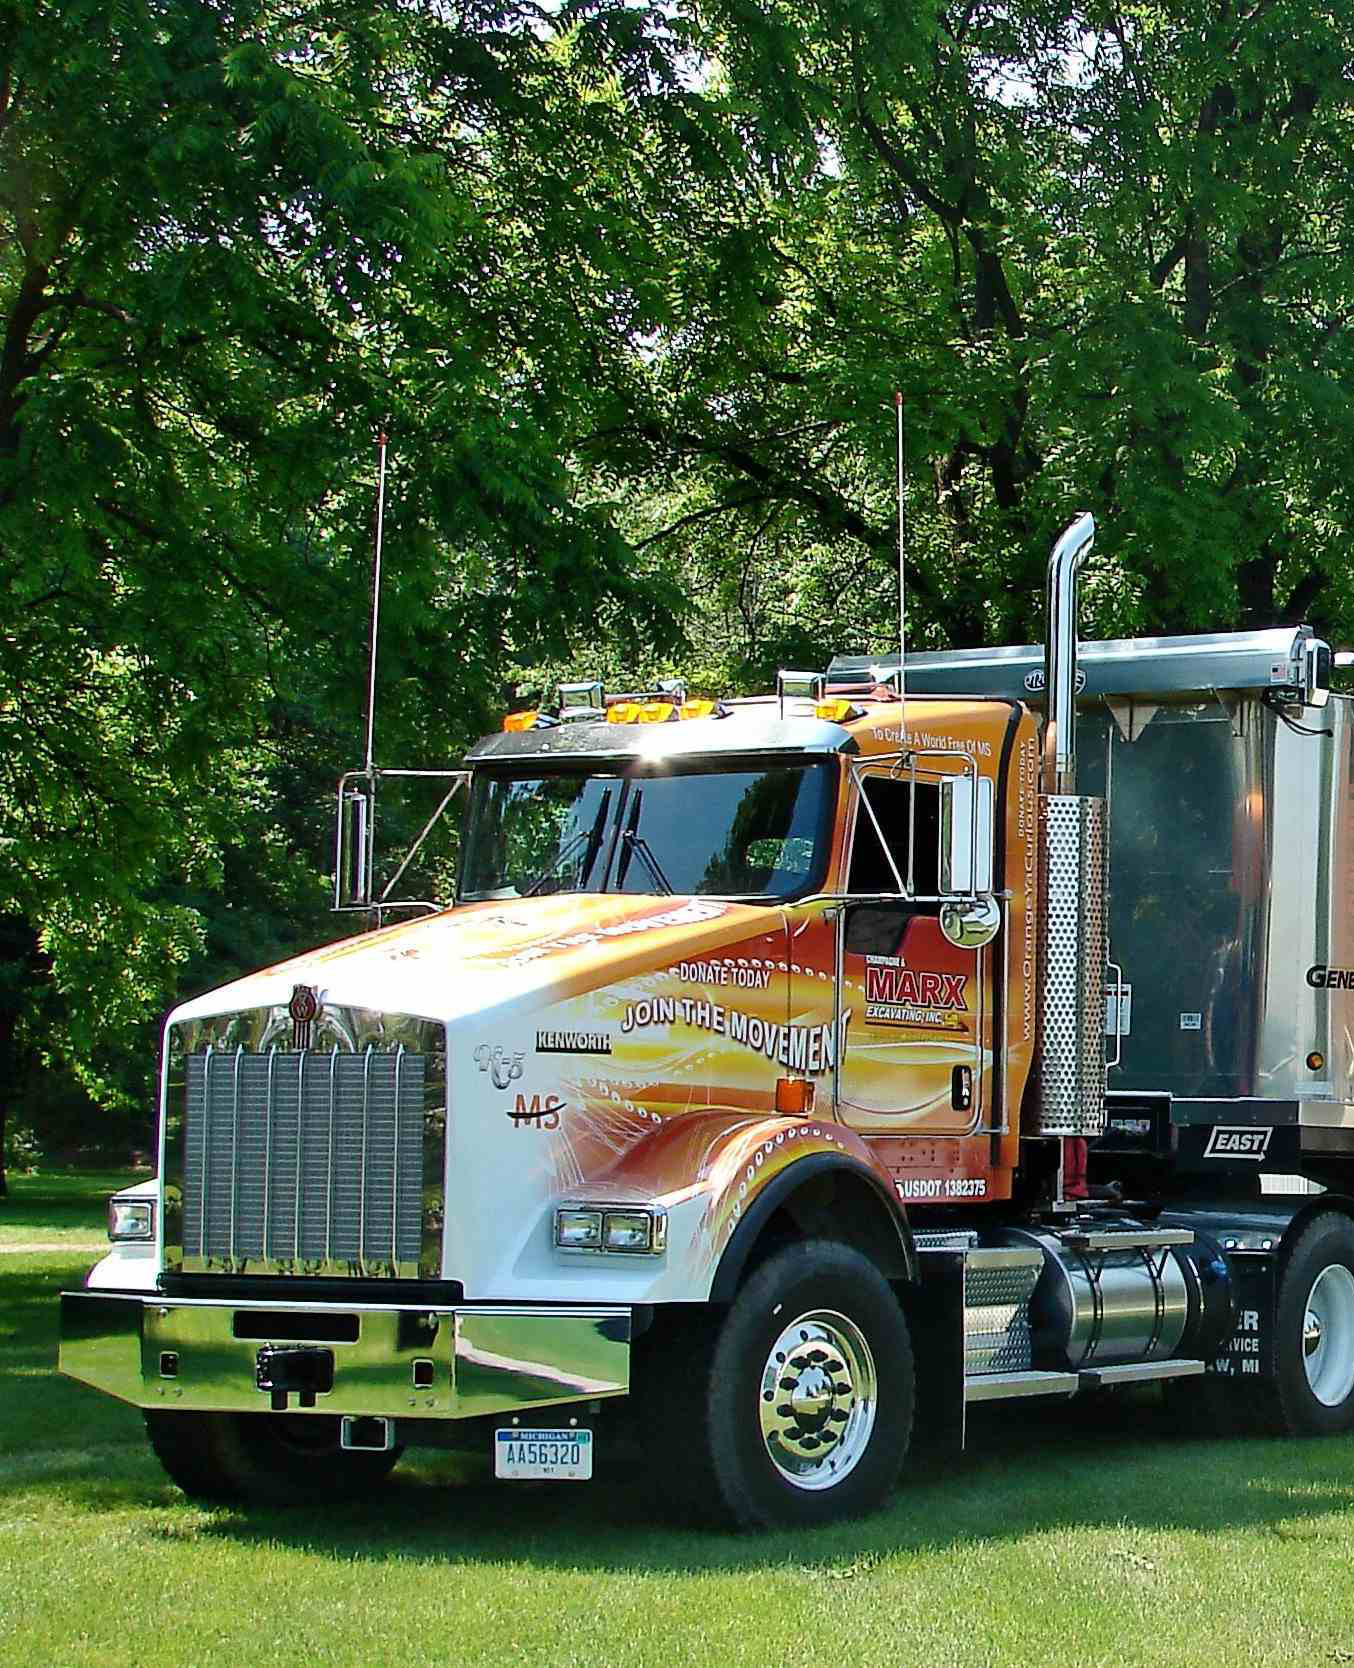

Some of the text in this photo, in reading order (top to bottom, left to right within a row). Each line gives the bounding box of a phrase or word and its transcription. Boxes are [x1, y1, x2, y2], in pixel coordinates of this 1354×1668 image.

[921, 732, 946, 749] World
[680, 962, 772, 989] DONATE TODAY
[865, 967, 968, 1010] MARX
[537, 1031, 612, 1051] KENWORTH
[621, 998, 852, 1075] JOIN THE MOVEMENT
[514, 1094, 561, 1130] MS
[1216, 1133, 1266, 1151] EAST
[904, 1180, 986, 1198] USDOT 1382375
[1242, 1358, 1260, 1374] MI
[520, 1431, 568, 1441] MICHIGAN
[507, 1443, 580, 1465] AA56320
